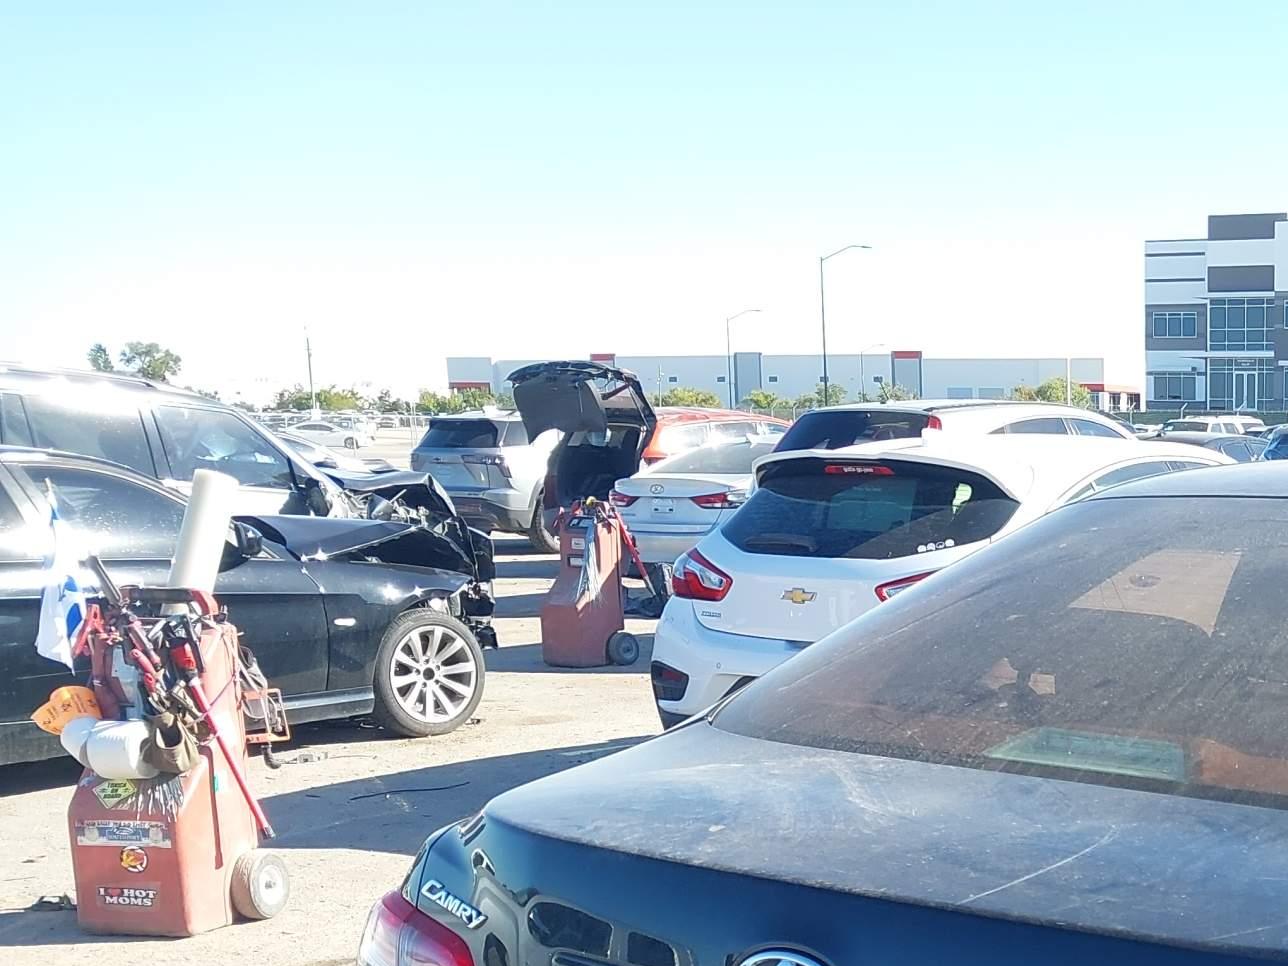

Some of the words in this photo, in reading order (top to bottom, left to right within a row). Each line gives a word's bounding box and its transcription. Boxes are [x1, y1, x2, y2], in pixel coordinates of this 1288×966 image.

[98, 887, 105, 896] I
[122, 888, 157, 899] HOT
[104, 895, 153, 906] MOMS
[421, 879, 486, 929] CAMRY
